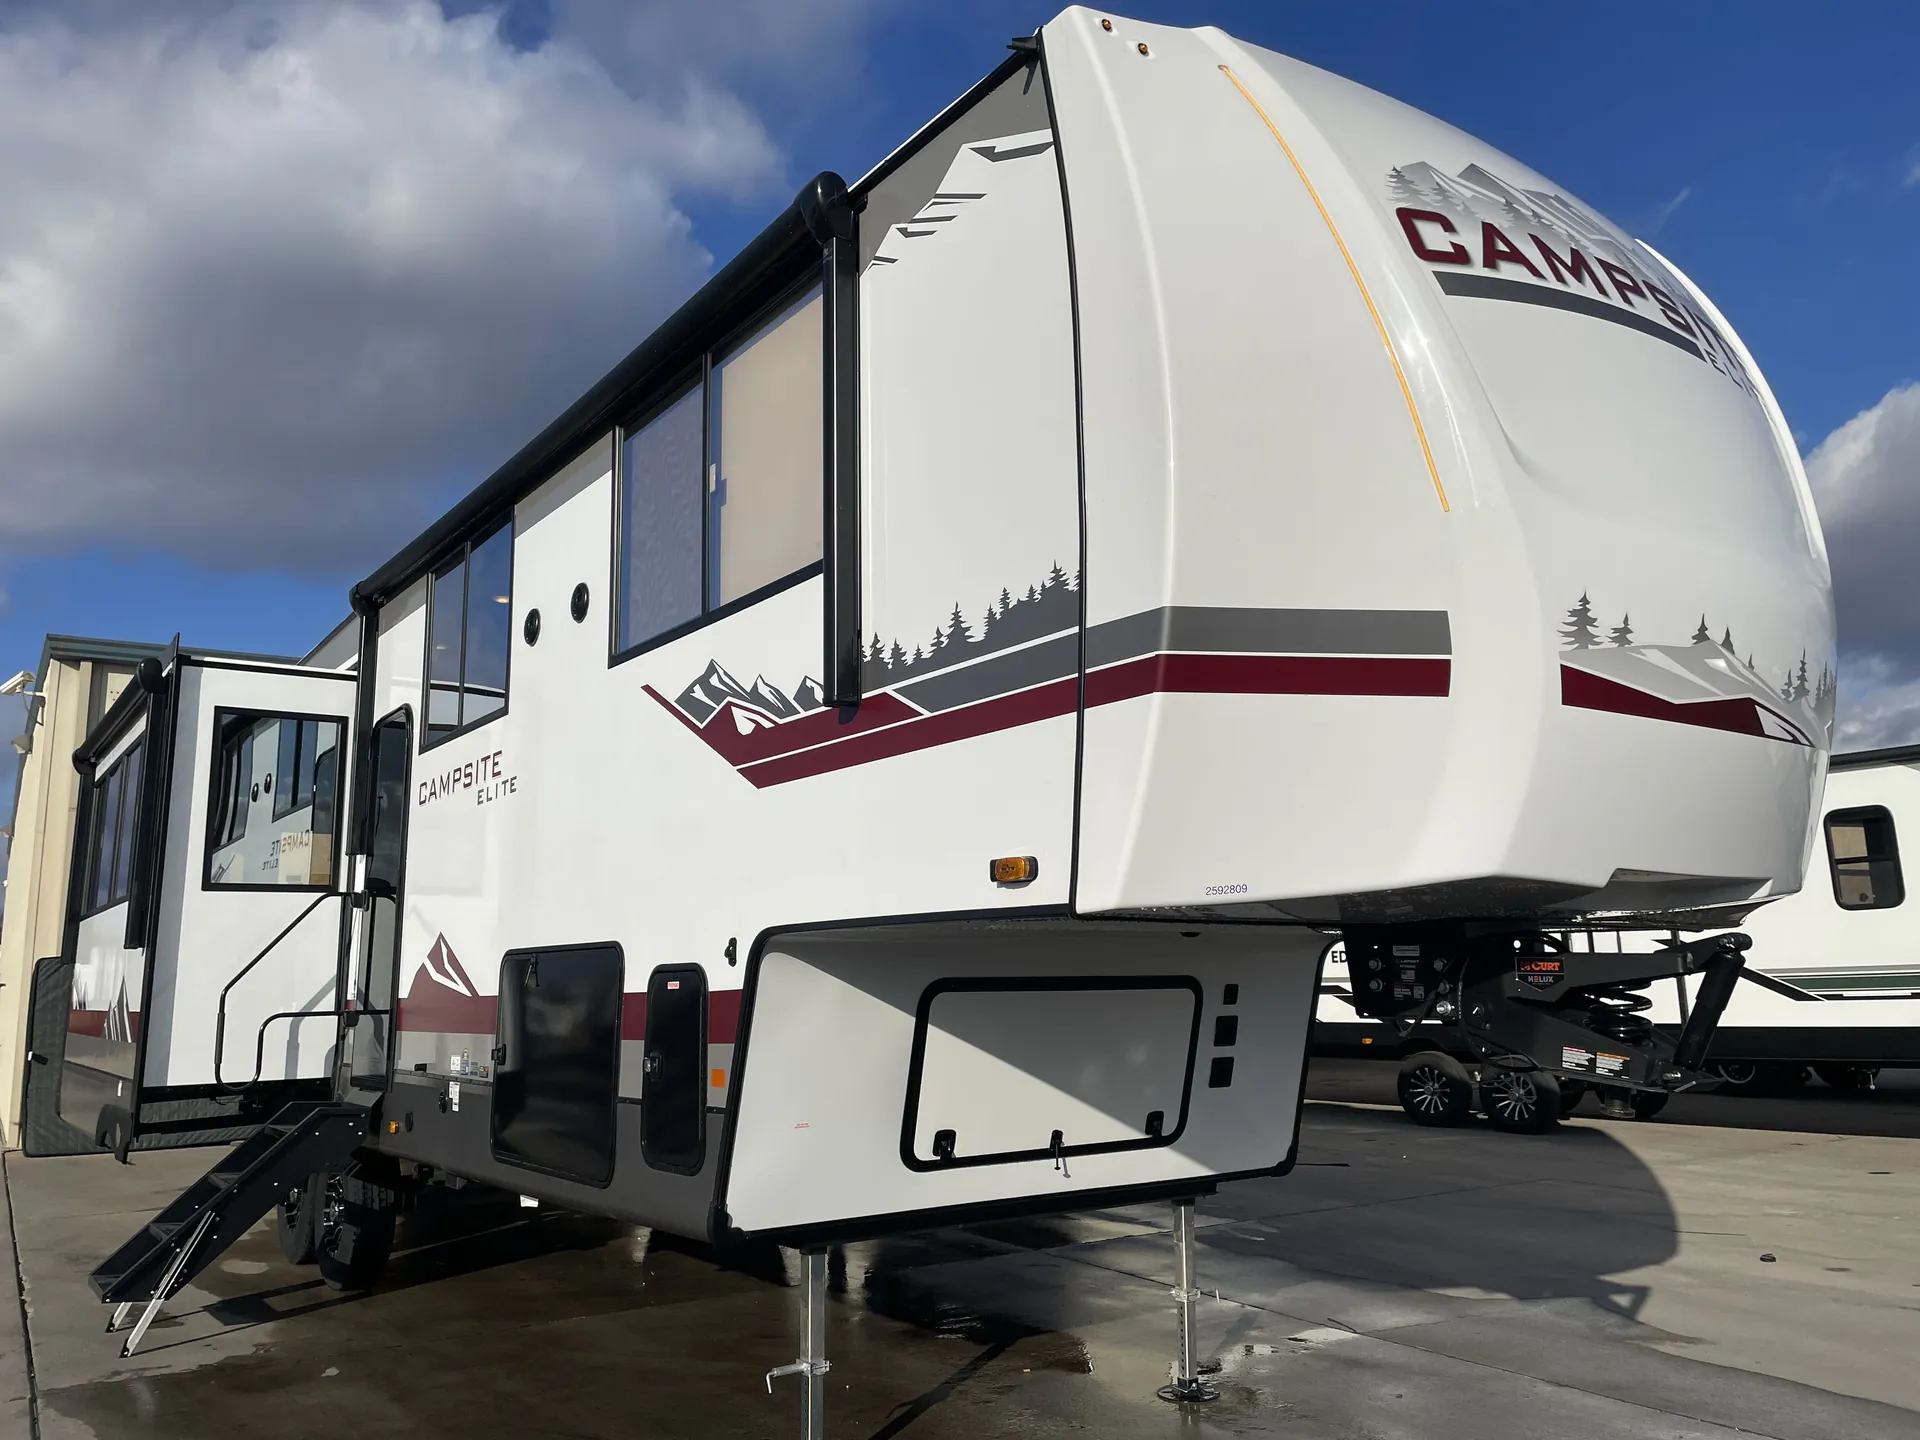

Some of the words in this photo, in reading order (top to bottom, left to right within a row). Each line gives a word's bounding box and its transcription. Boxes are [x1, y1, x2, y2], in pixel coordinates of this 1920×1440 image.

[418, 750, 503, 806] CAMPSITE
[477, 776, 518, 806] ELITE
[1205, 883, 1248, 896] 2592809
[1531, 961, 1561, 971] CURT
[1528, 975, 1554, 983] HELUX
